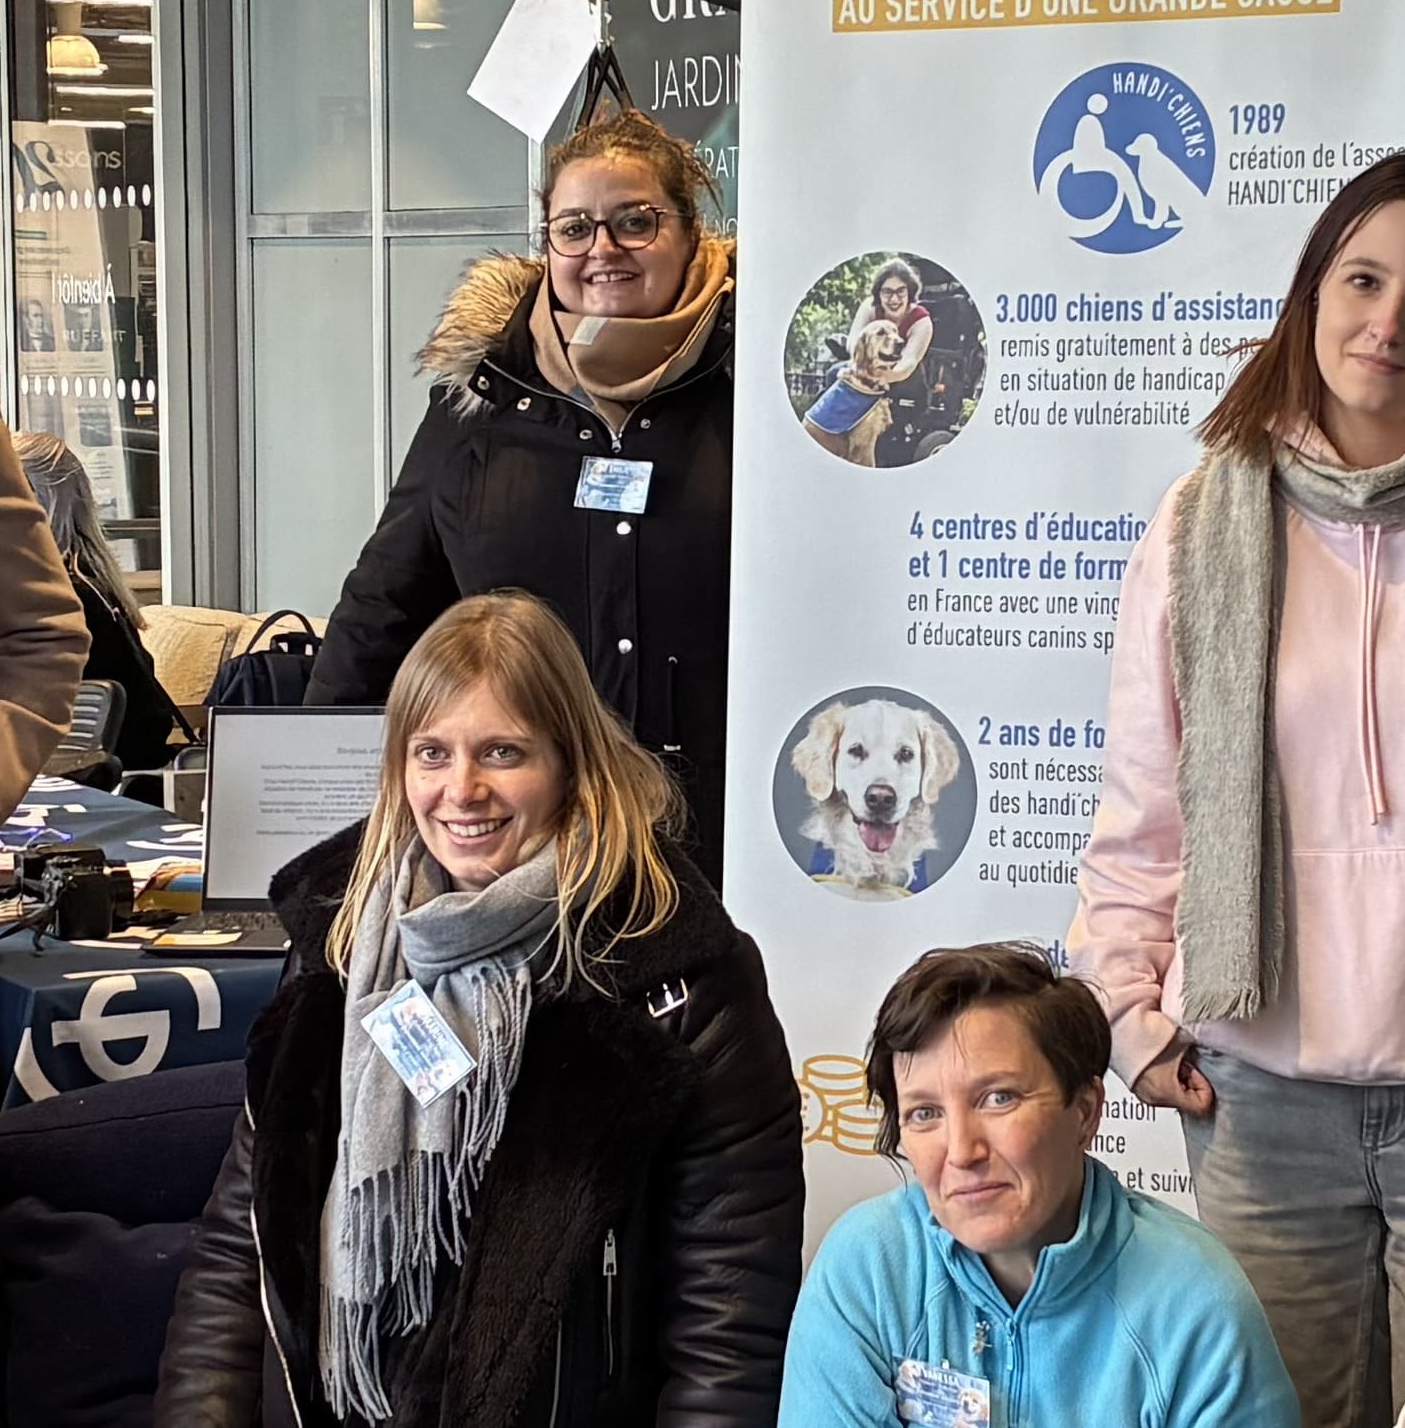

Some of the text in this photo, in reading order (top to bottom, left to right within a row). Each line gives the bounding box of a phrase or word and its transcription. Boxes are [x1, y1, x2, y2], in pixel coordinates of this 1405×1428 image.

[1111, 71, 1207, 160] HANDI'CHIENS
[1229, 103, 1286, 135] 1989
[1228, 144, 1305, 171] création
[1312, 142, 1335, 168] de
[996, 293, 1058, 323] 3.000
[1066, 292, 1144, 322] chiens
[1001, 333, 1050, 357] remis
[1056, 333, 1176, 363] gratuitement
[1182, 333, 1192, 356] à
[1200, 332, 1231, 356] des
[1000, 367, 1225, 396] en situation de handicap
[994, 399, 1190, 427] et/ou de vulnérabilité
[910, 510, 924, 540] 4
[932, 513, 1017, 541] centres
[908, 550, 931, 578] et
[938, 549, 948, 578] 1
[958, 551, 1031, 579] centre
[1039, 551, 1066, 580] de
[907, 593, 928, 612] en
[935, 588, 993, 613] France
[999, 595, 1039, 614] avec
[1046, 595, 1078, 614] une
[907, 621, 1021, 648] d'éducateurs
[1028, 625, 1086, 649] canins
[978, 715, 991, 745] 2
[999, 723, 1040, 747] ans
[1048, 718, 1076, 748] de
[989, 758, 1028, 781] sont
[989, 790, 1020, 814] des
[989, 825, 1006, 848] et
[979, 862, 1000, 881] au
[1127, 1168, 1145, 1189] et
